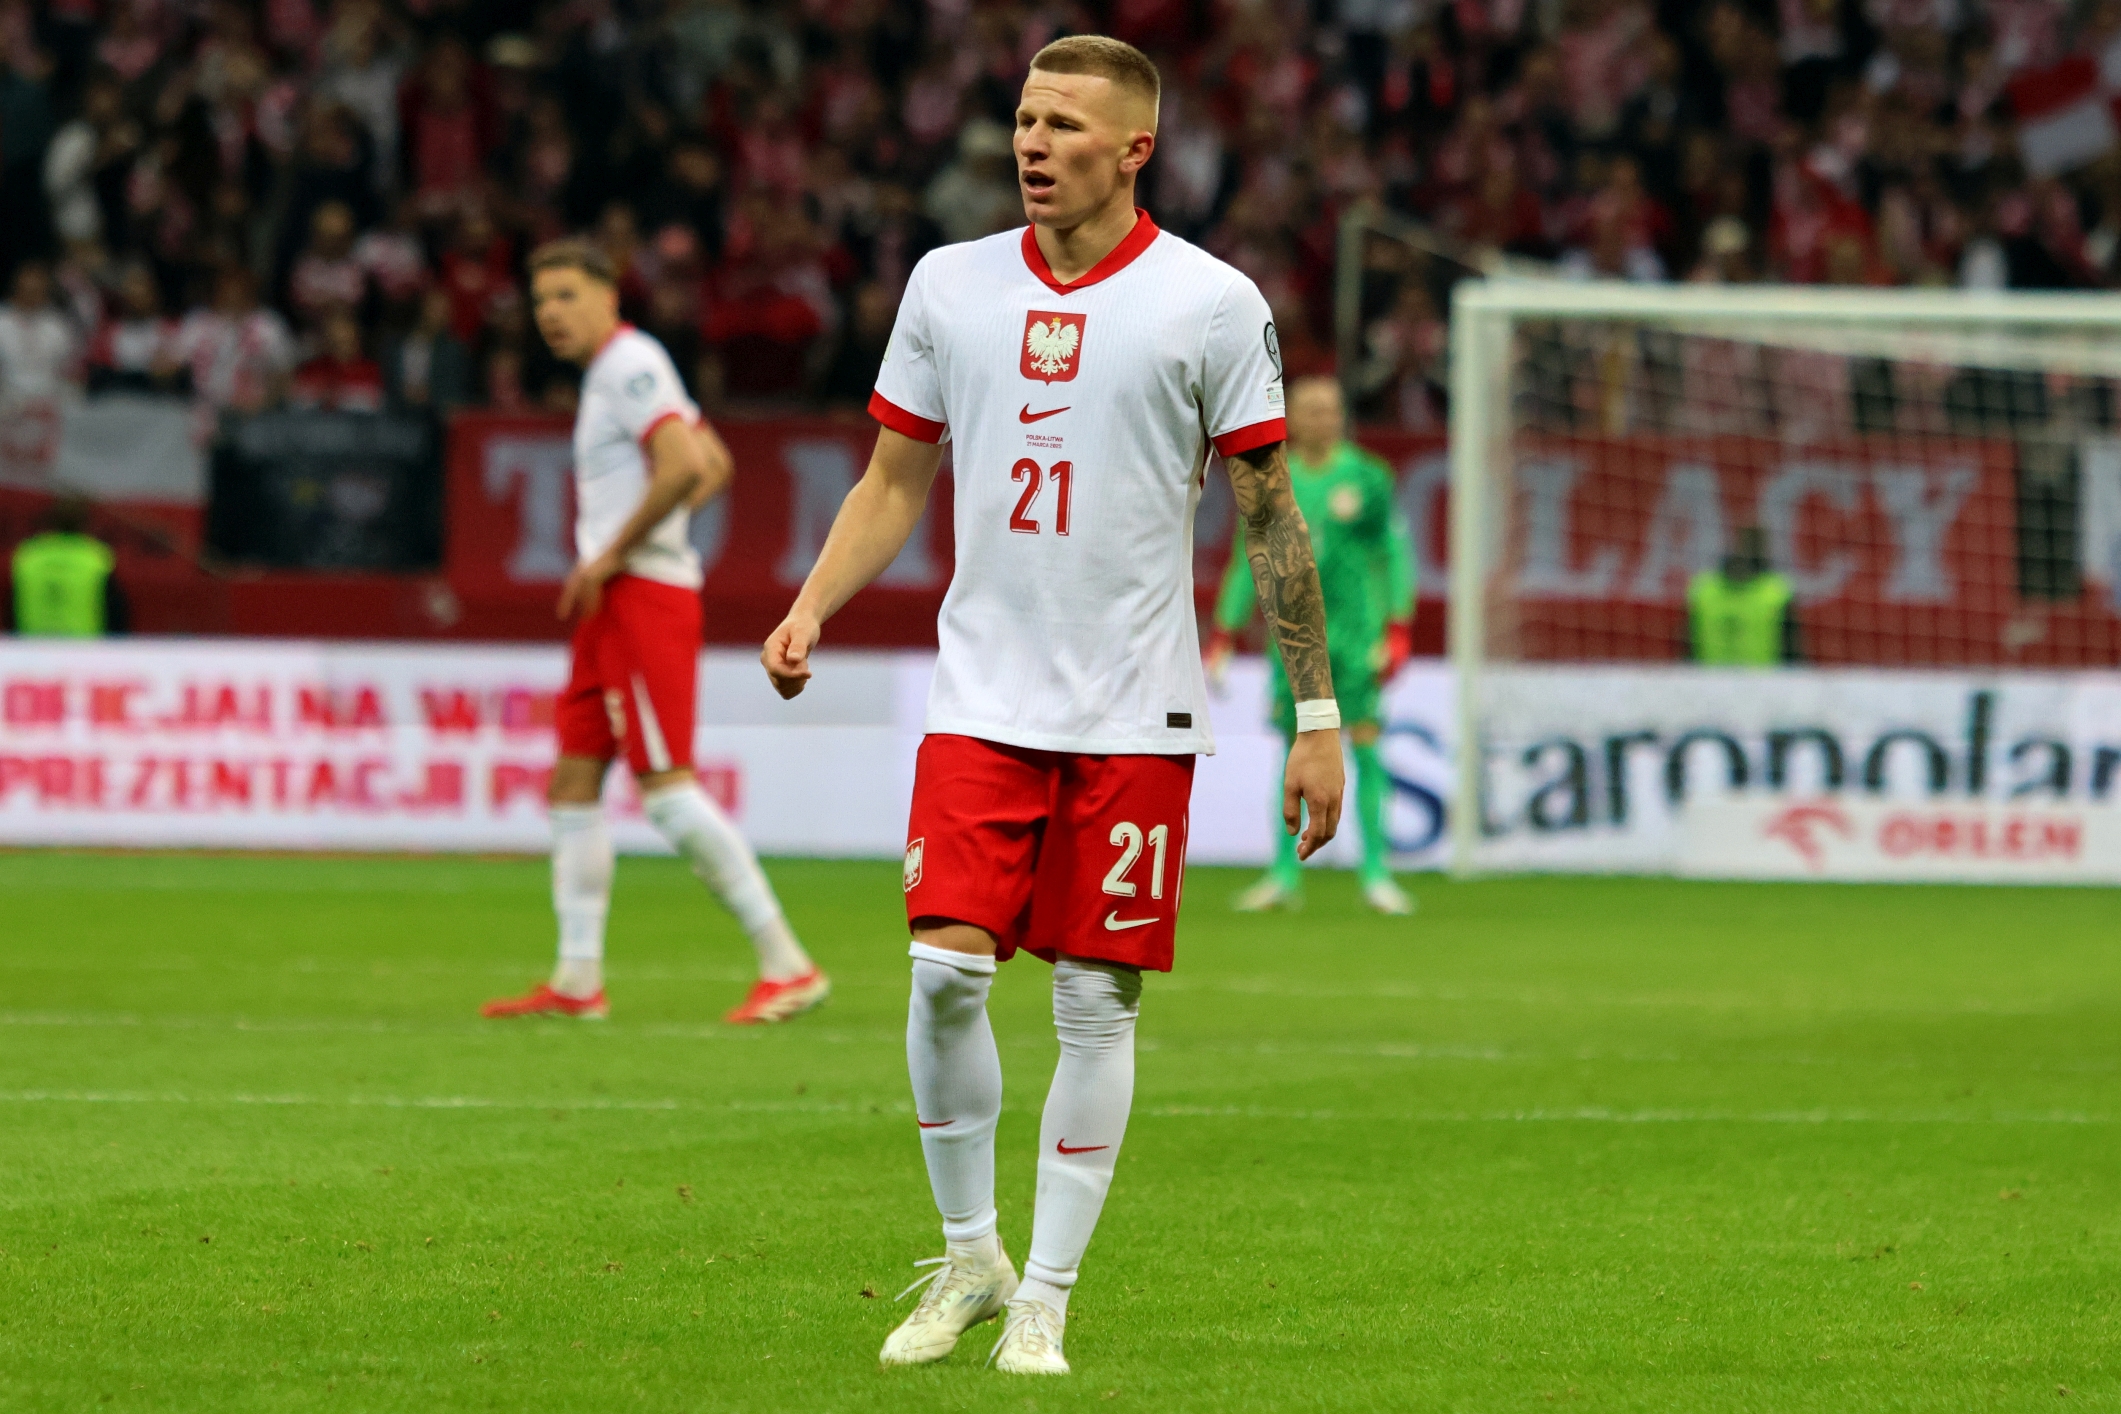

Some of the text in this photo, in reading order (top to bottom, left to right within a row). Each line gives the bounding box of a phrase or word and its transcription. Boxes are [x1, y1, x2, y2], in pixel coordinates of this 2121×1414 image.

[1025, 434, 1064, 443] POLSKA-LITWA
[1009, 457, 1073, 537] 21
[1101, 821, 1168, 899] 21
